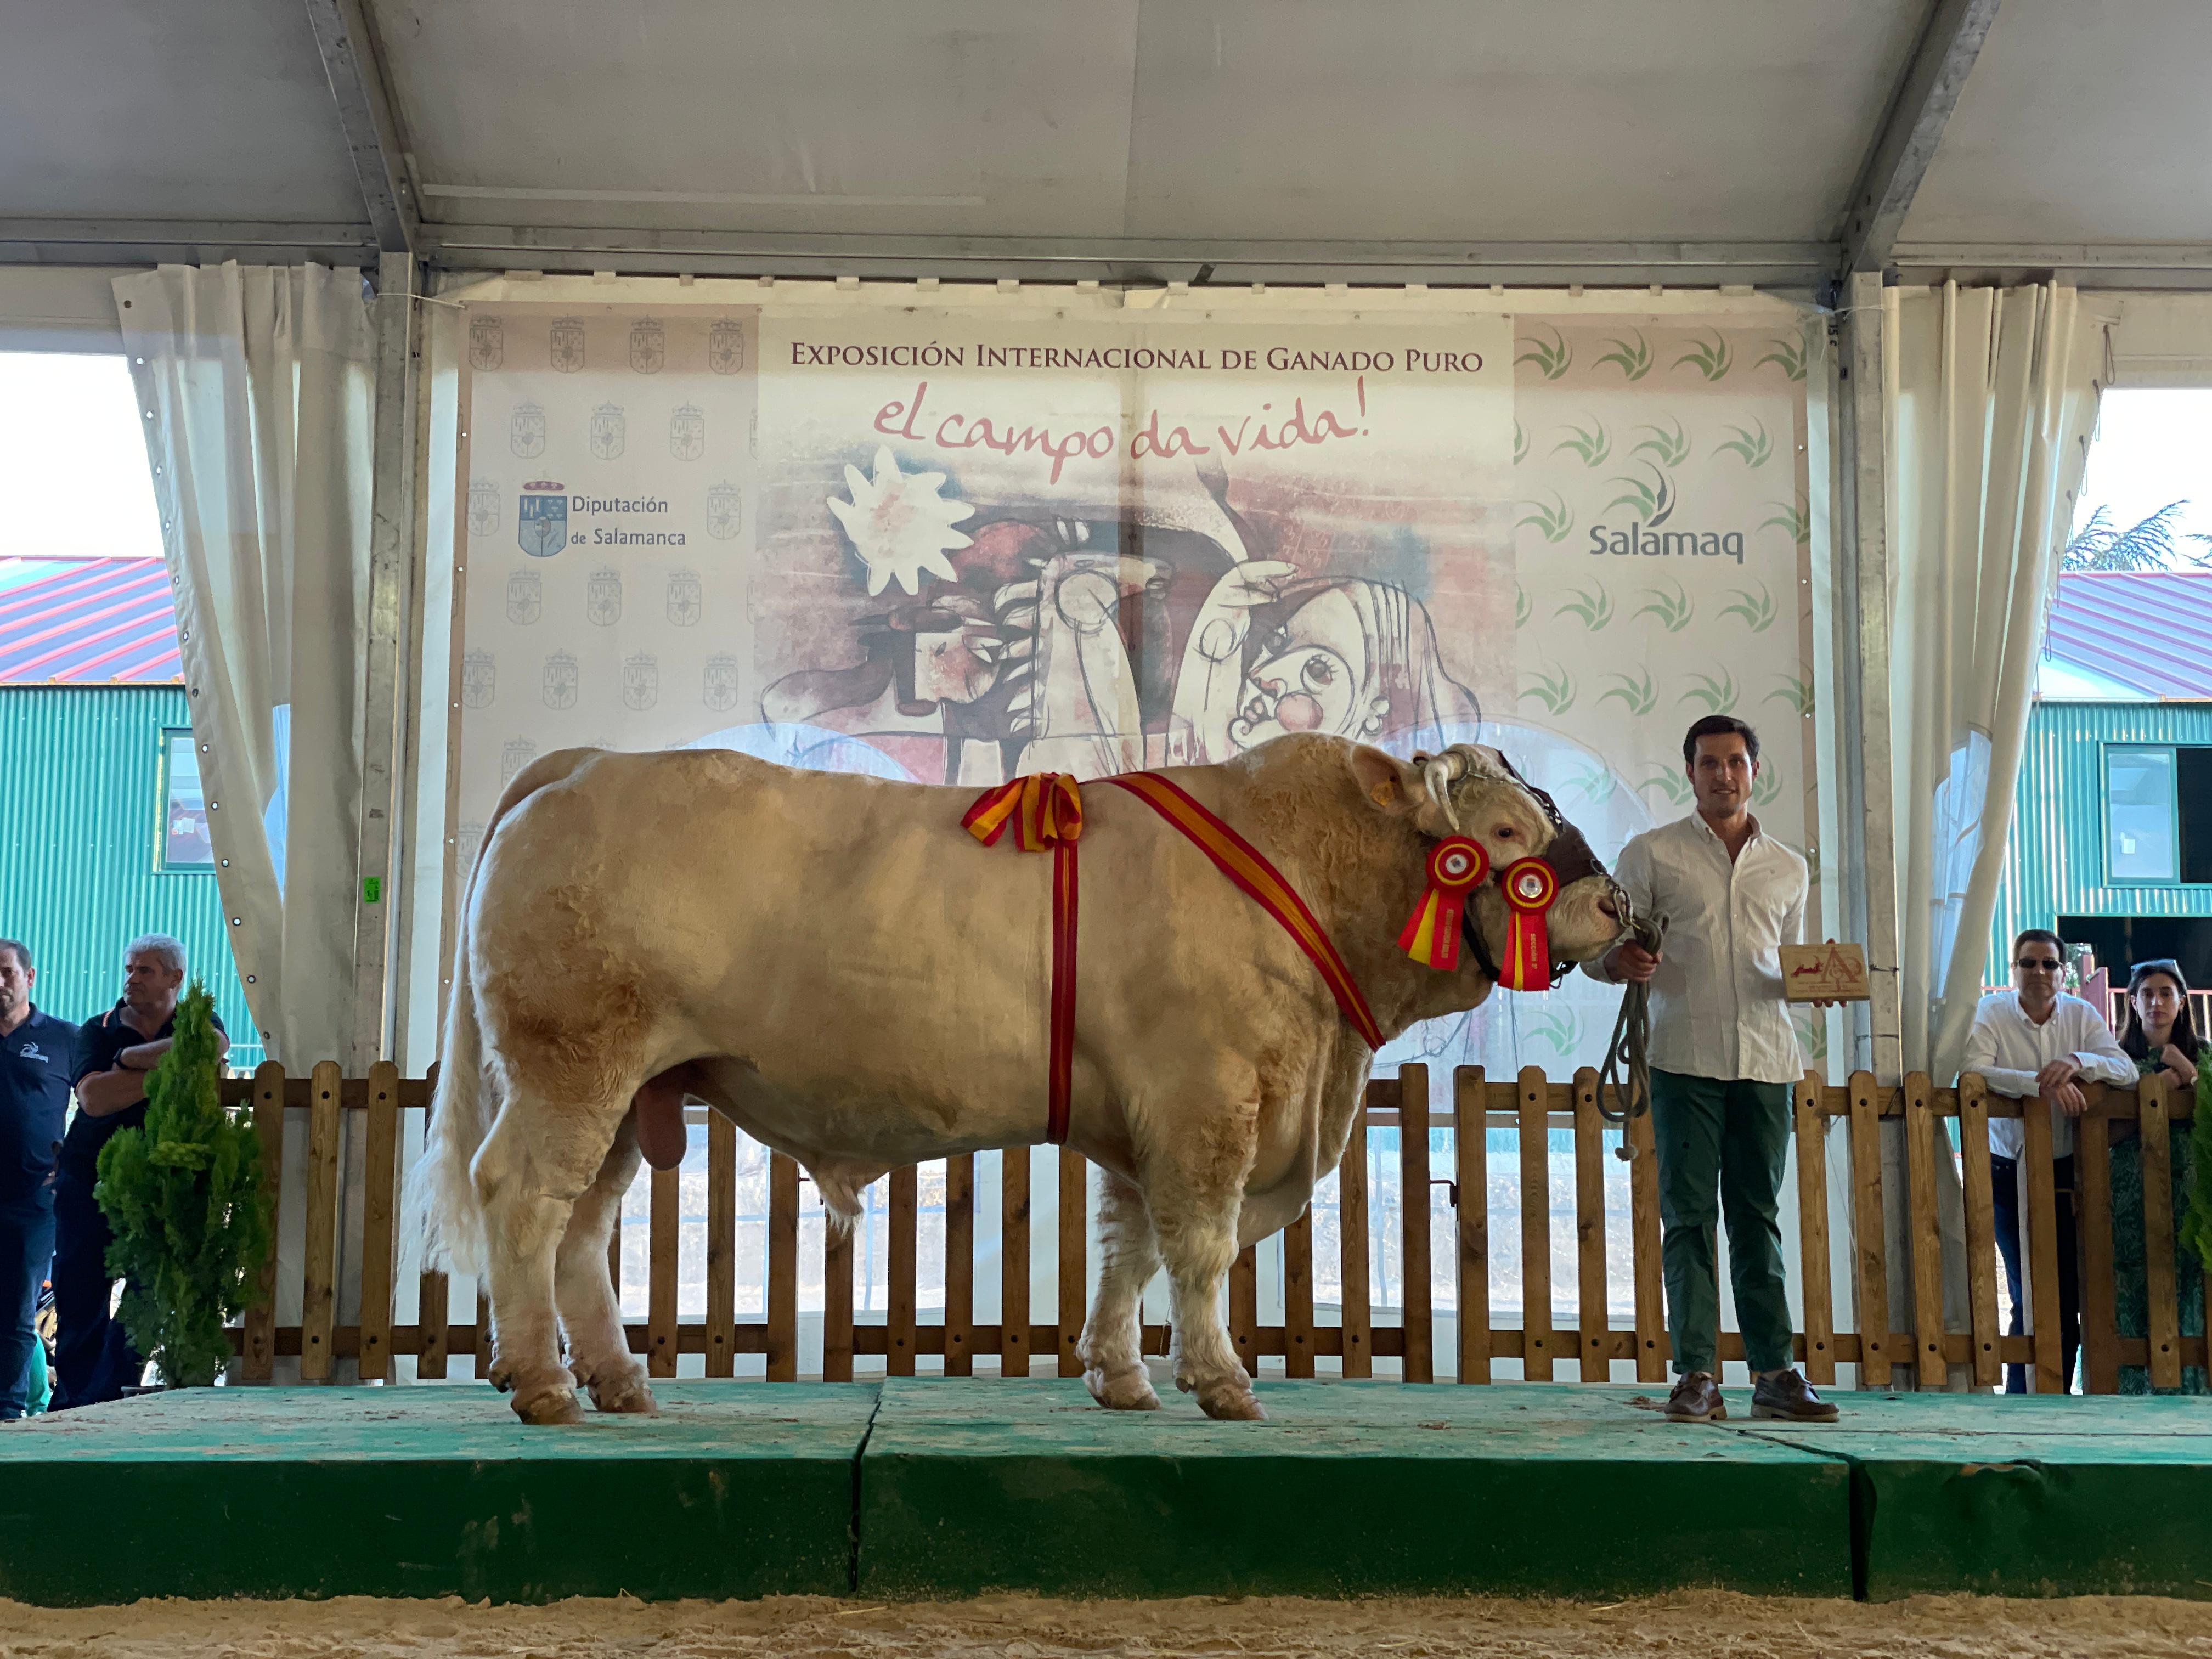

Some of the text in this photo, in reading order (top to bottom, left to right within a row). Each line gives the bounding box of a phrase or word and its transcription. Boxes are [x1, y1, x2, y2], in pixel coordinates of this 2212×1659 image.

[790, 340, 1483, 373] EXPOSICIÓN INTERNACIONAL DE GANADO PURO
[873, 375, 1369, 486] el campo da vida!
[572, 496, 668, 516] Diputación
[571, 528, 686, 545] de Salamanca
[1589, 522, 1744, 565] Salamaq
